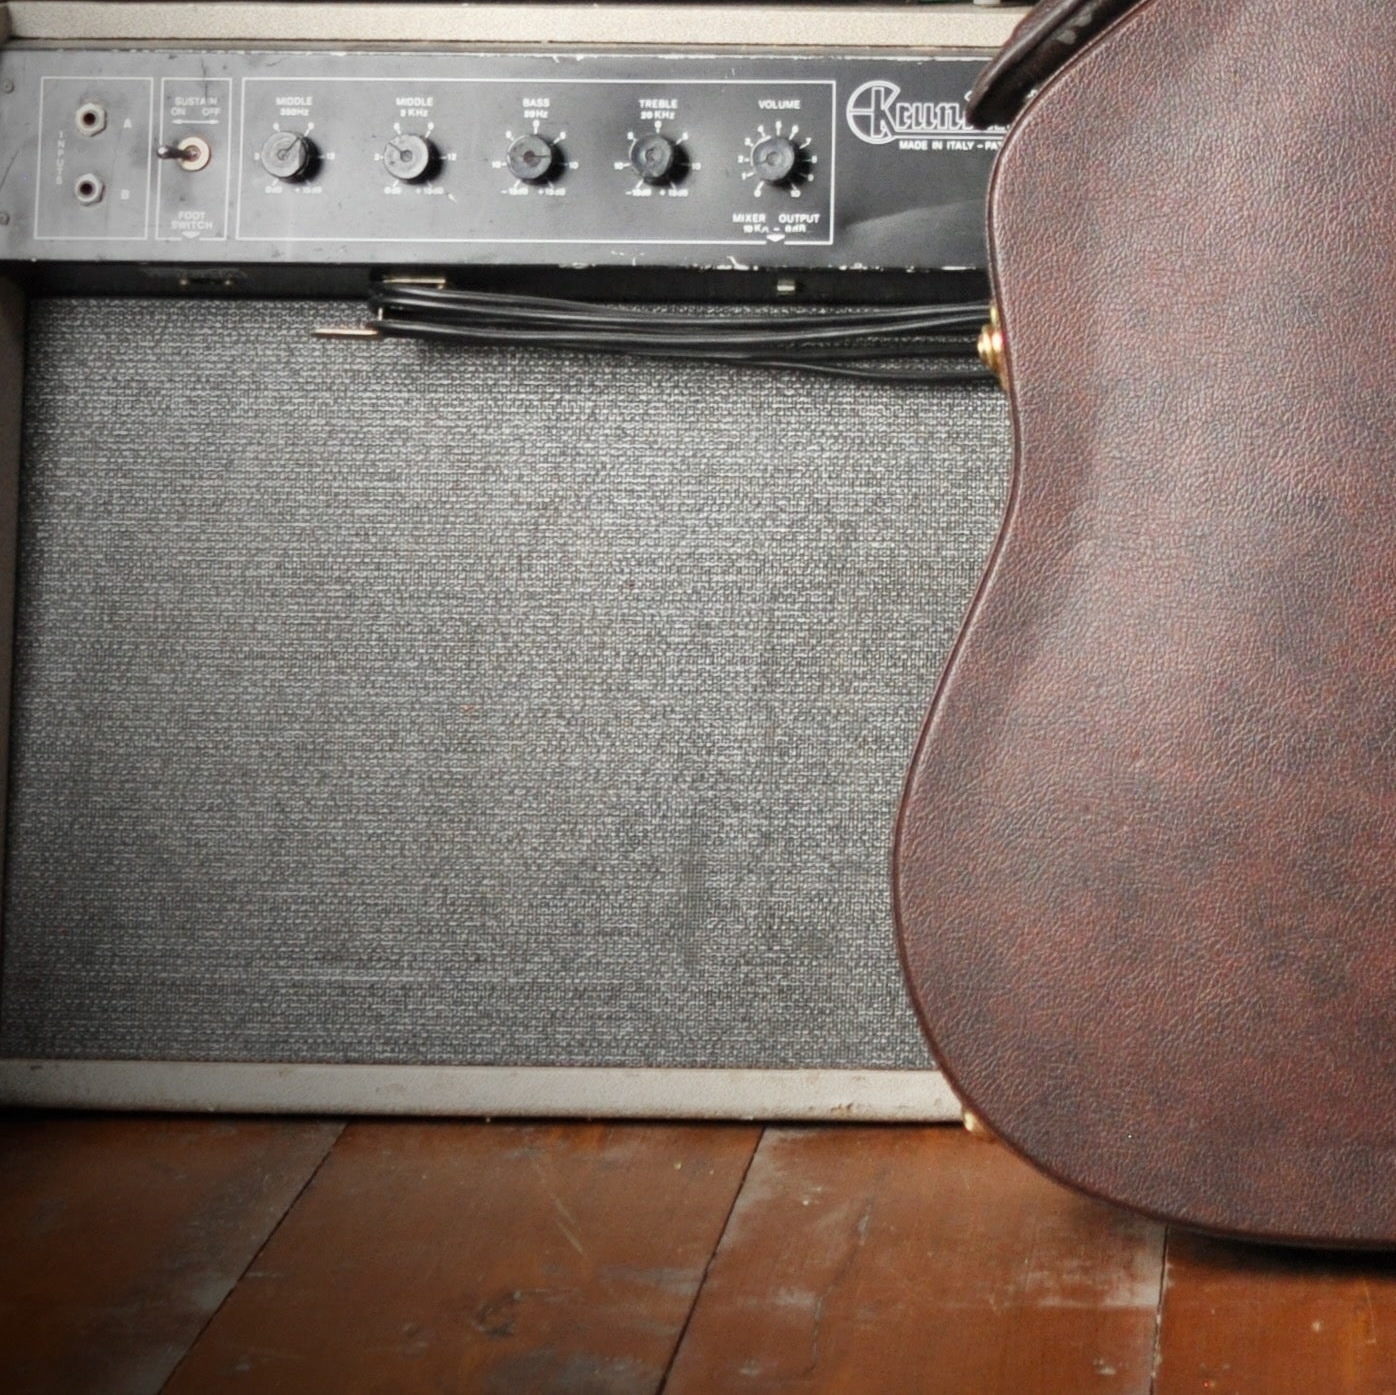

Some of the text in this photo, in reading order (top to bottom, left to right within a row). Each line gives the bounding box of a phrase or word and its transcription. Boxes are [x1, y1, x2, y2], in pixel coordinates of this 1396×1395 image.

[175, 97, 217, 105] SUSTAIN
[276, 97, 313, 106] MIDDLE
[396, 97, 433, 106] MIDDLE
[523, 98, 550, 108] BASS
[639, 99, 678, 109] TREBLE
[758, 100, 801, 109] VOLUME
[171, 107, 221, 116] ON OFF
[123, 118, 132, 129] A
[899, 140, 928, 150] MADE
[932, 140, 943, 150] IN
[946, 140, 975, 150] ITALY
[120, 189, 130, 201] B
[178, 211, 206, 220] FOOT
[732, 213, 820, 223] MIXER OUTPUT
[171, 221, 213, 229] SWITCH
